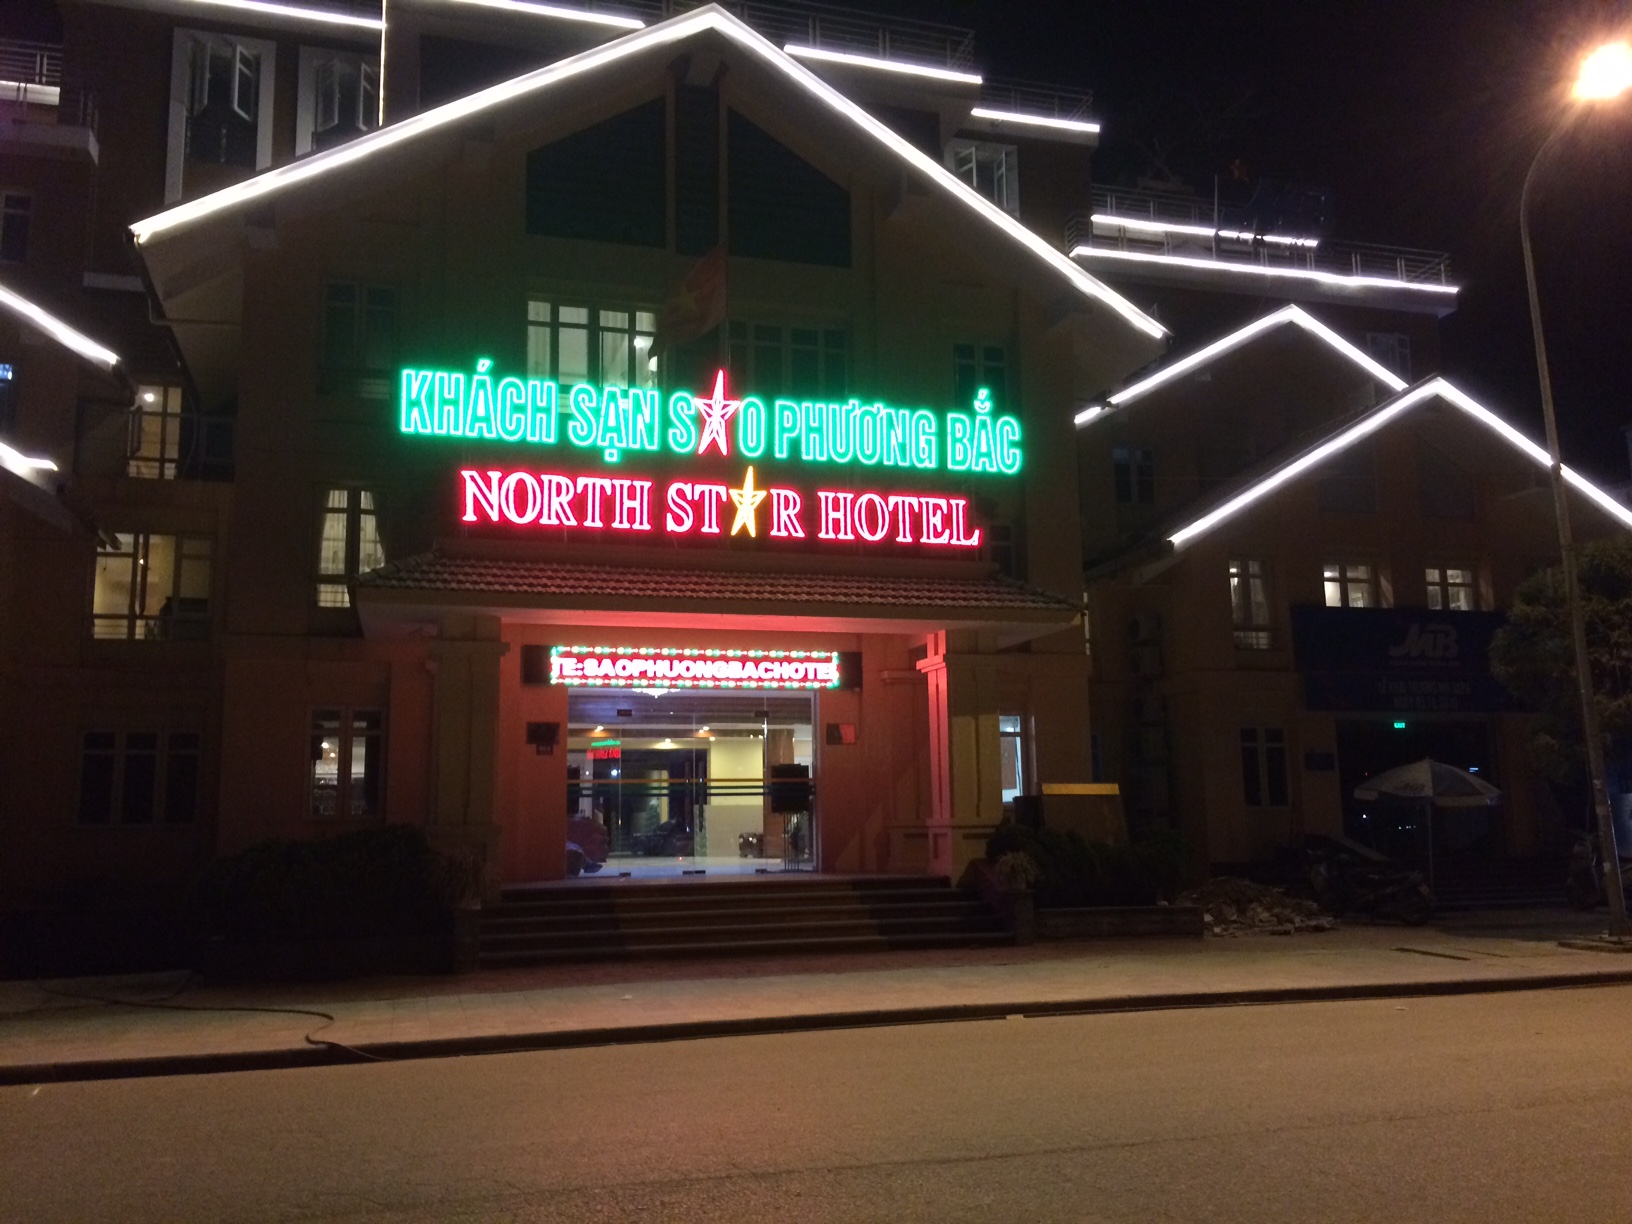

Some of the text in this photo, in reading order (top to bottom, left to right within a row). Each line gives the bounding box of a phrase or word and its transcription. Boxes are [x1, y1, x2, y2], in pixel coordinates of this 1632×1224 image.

[401, 358, 558, 443] KHÁCH
[568, 383, 660, 462] SẠN
[774, 399, 937, 468] PHƯƠNG
[946, 388, 1021, 474] BẮC
[461, 466, 980, 545] NORTH STAR HOTEL
